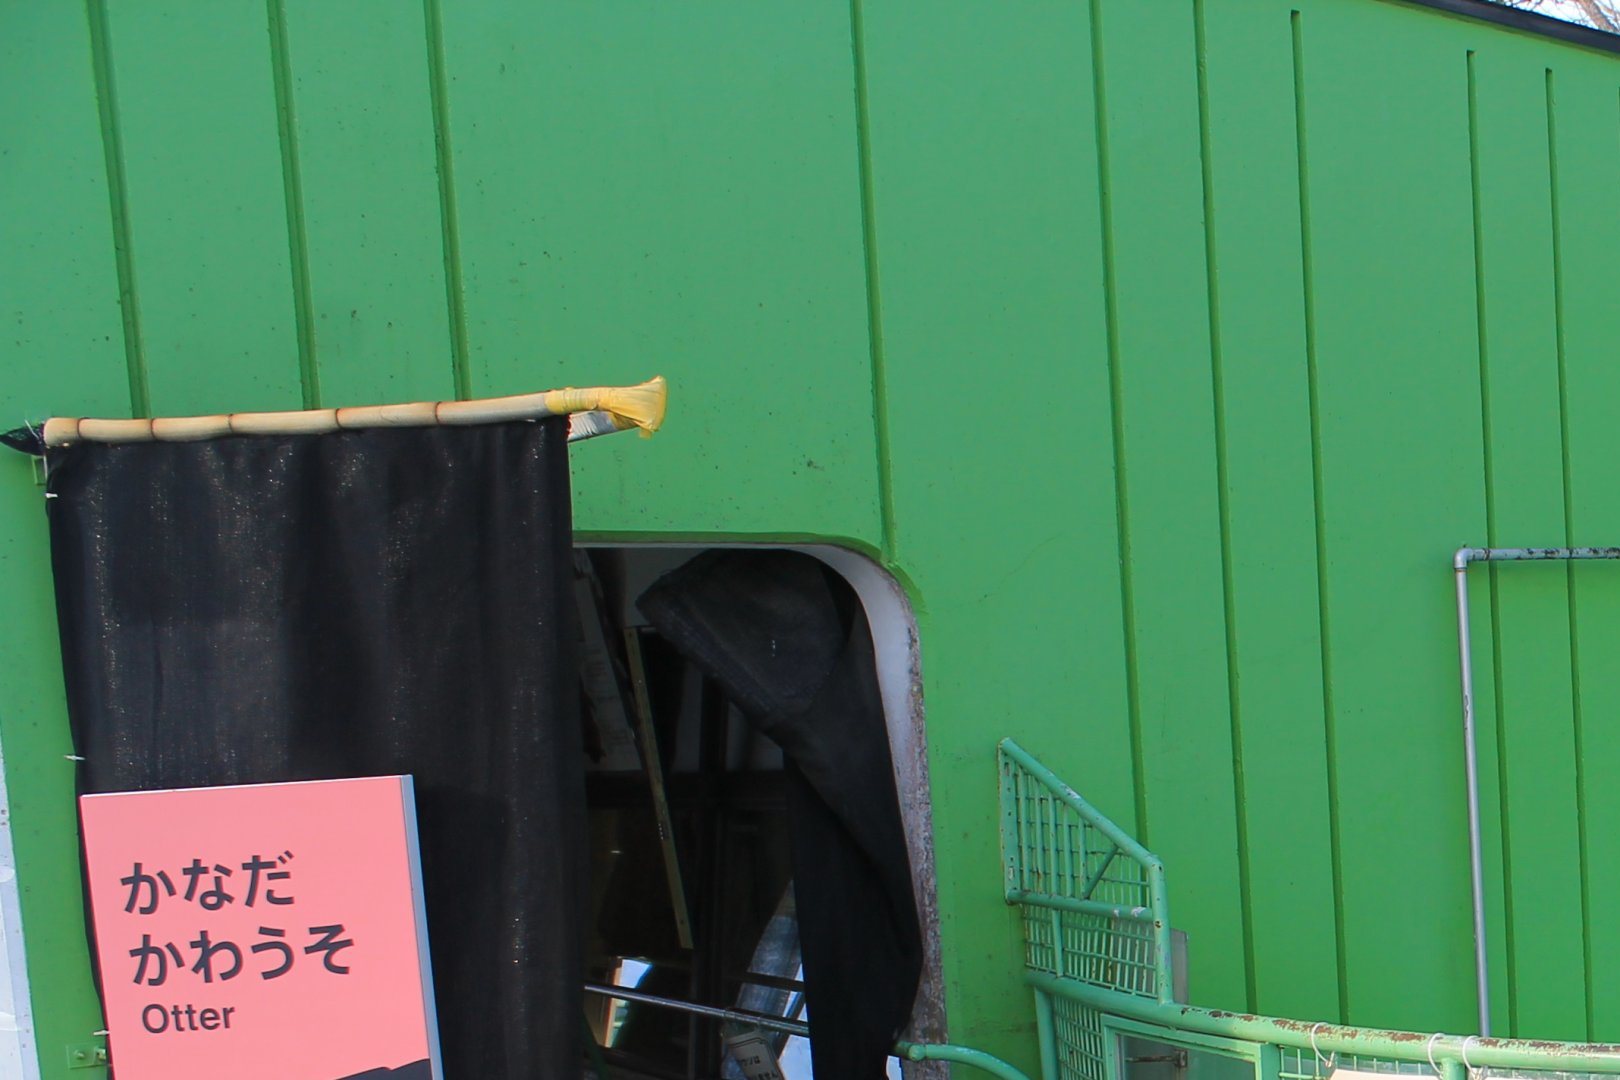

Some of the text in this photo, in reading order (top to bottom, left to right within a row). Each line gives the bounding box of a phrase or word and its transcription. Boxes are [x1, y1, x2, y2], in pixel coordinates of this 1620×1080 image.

[120, 850, 295, 915] かなだ
[129, 923, 355, 987] かわうそ
[141, 1003, 235, 1034] Otter
